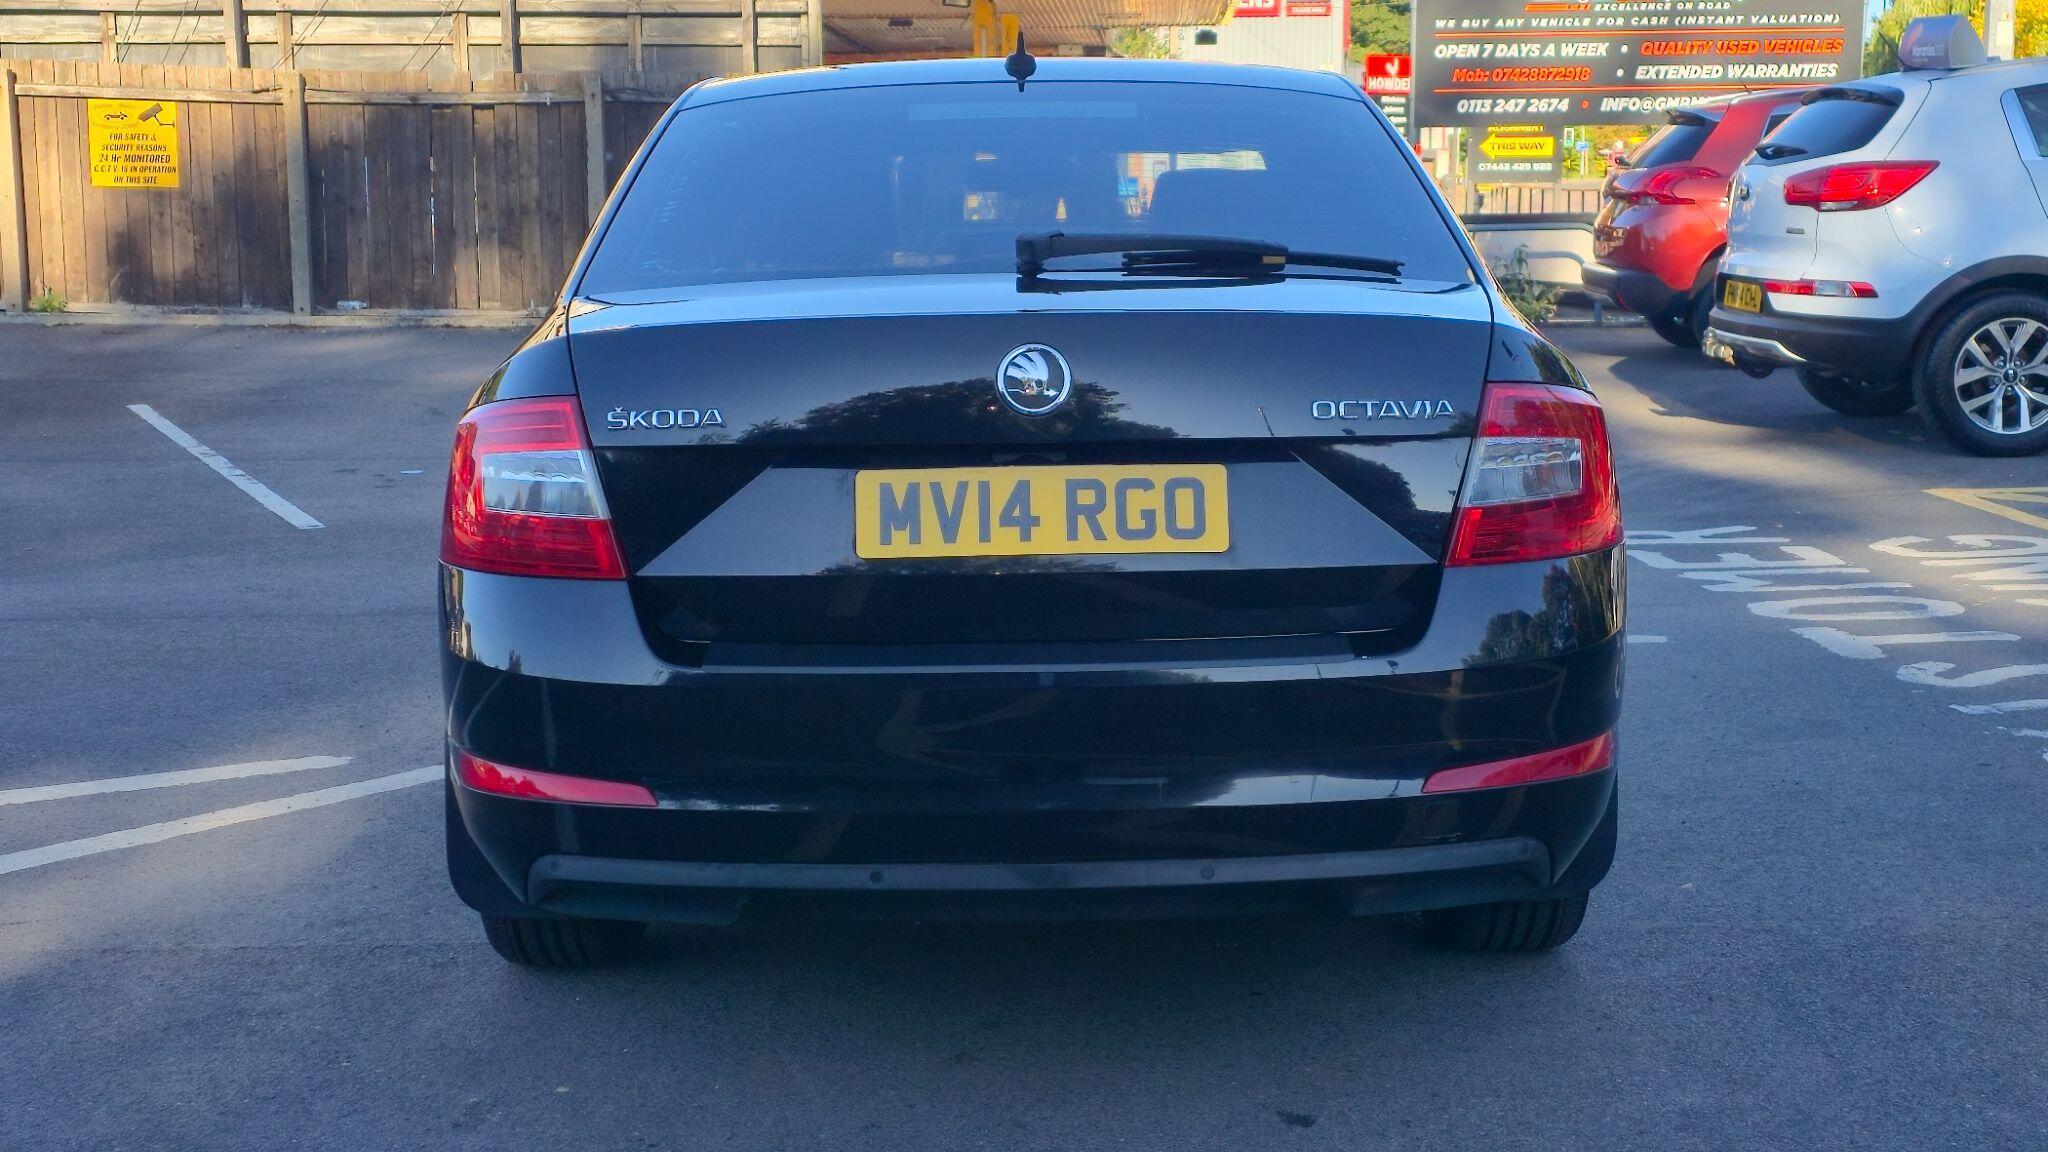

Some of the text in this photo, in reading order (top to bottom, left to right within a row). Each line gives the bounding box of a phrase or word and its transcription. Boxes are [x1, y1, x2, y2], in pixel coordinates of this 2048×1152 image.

[1594, 2, 1671, 11] EXCELLENCE
[1677, 2, 1693, 10] ON
[1435, 14, 1841, 28] WE BUY ANY VEHICLE FOR CASH (INSTANT VALUATION)
[1435, 42, 1610, 58] OPEN 7 DAYS A WEEK
[1641, 38, 1844, 56] QUALITY USED VEHICLES
[1452, 67, 1592, 82] Mob: 07428872918
[1635, 63, 1839, 79] EXTENDED WARRANTIES
[1457, 98, 1570, 113] 0113 247 2674
[109, 133, 157, 141] FOR SAFETY &
[101, 143, 167, 152] SECURITY REASONS
[1490, 141, 1545, 151] THIS WAY
[98, 154, 171, 163] 24 Hr MONITORED
[121, 165, 128, 173] IS
[130, 165, 138, 173] IN
[139, 165, 177, 174] OPERATION
[113, 175, 158, 184] ON THIS SITE
[1312, 400, 1456, 419] OCTAVIA
[607, 406, 724, 429] ŠKODA
[879, 476, 1206, 546] MV14 RGO
